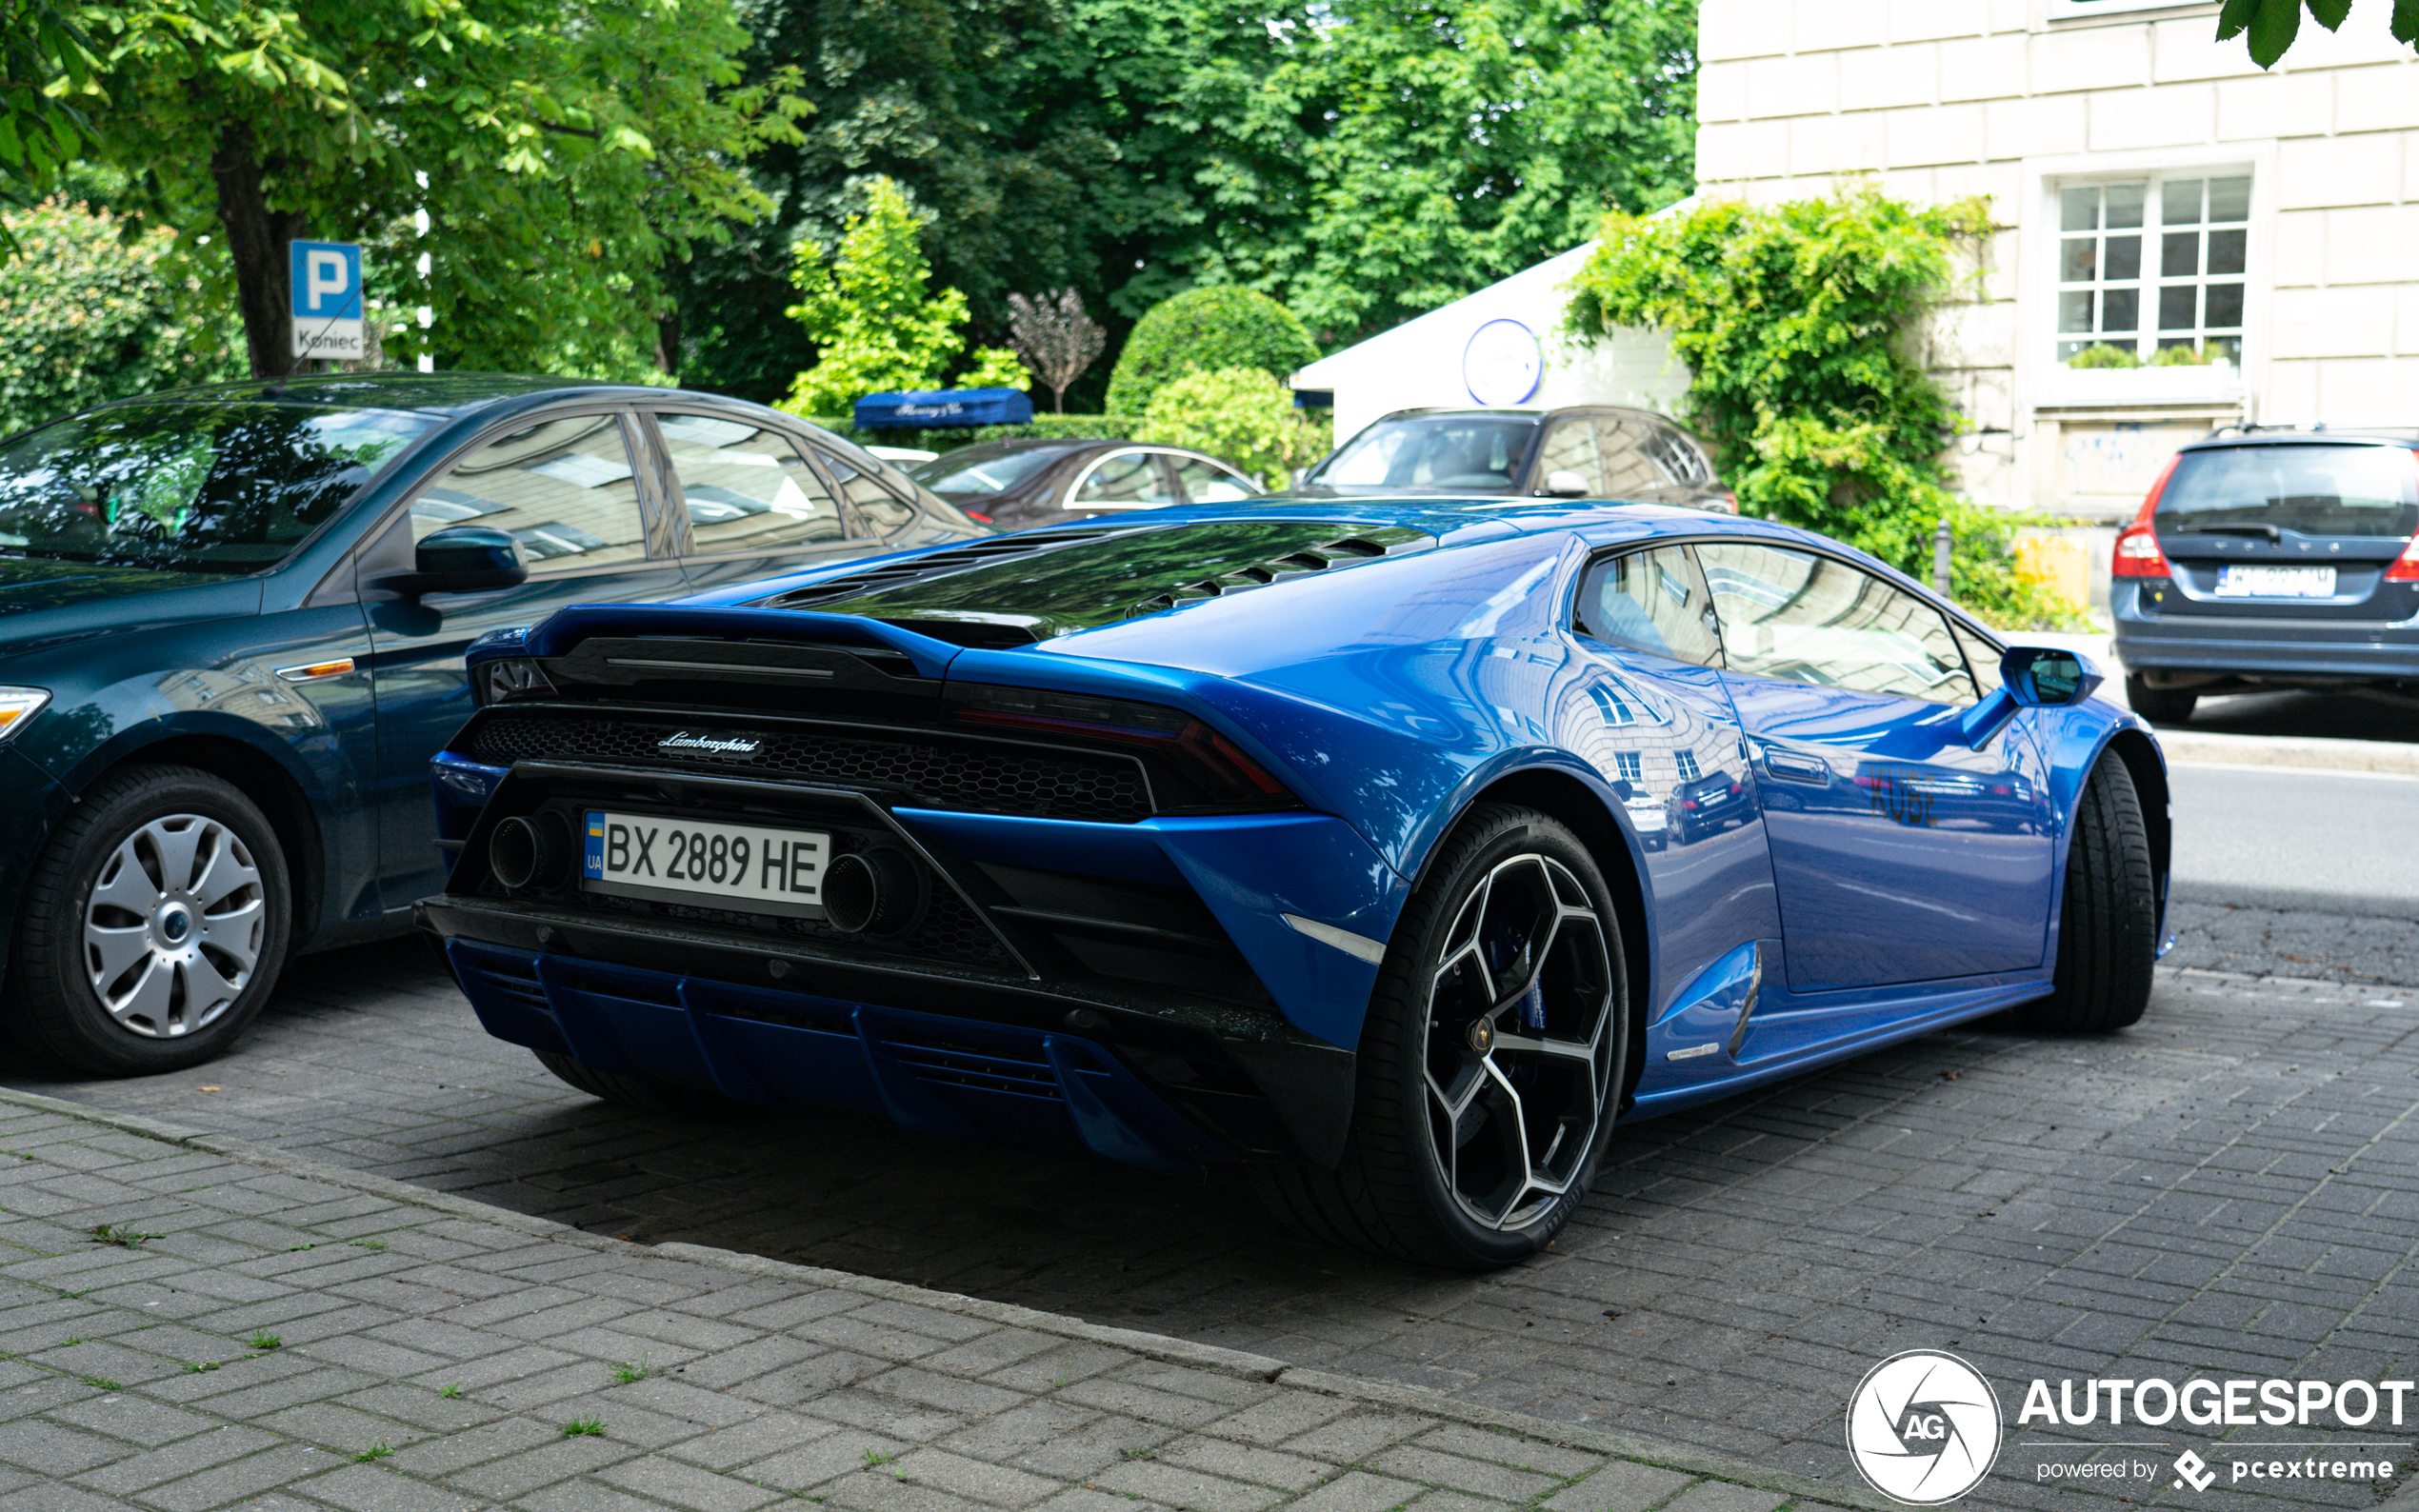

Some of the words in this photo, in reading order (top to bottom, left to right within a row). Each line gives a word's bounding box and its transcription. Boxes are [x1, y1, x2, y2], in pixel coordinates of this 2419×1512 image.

[308, 249, 348, 310] P
[299, 329, 359, 350] Koniec
[657, 730, 760, 753] Lamborghini
[1870, 766, 1938, 826] KUBE
[588, 855, 602, 870] UA
[608, 824, 659, 877] BX
[667, 830, 750, 886] 2889
[762, 839, 817, 894] HE
